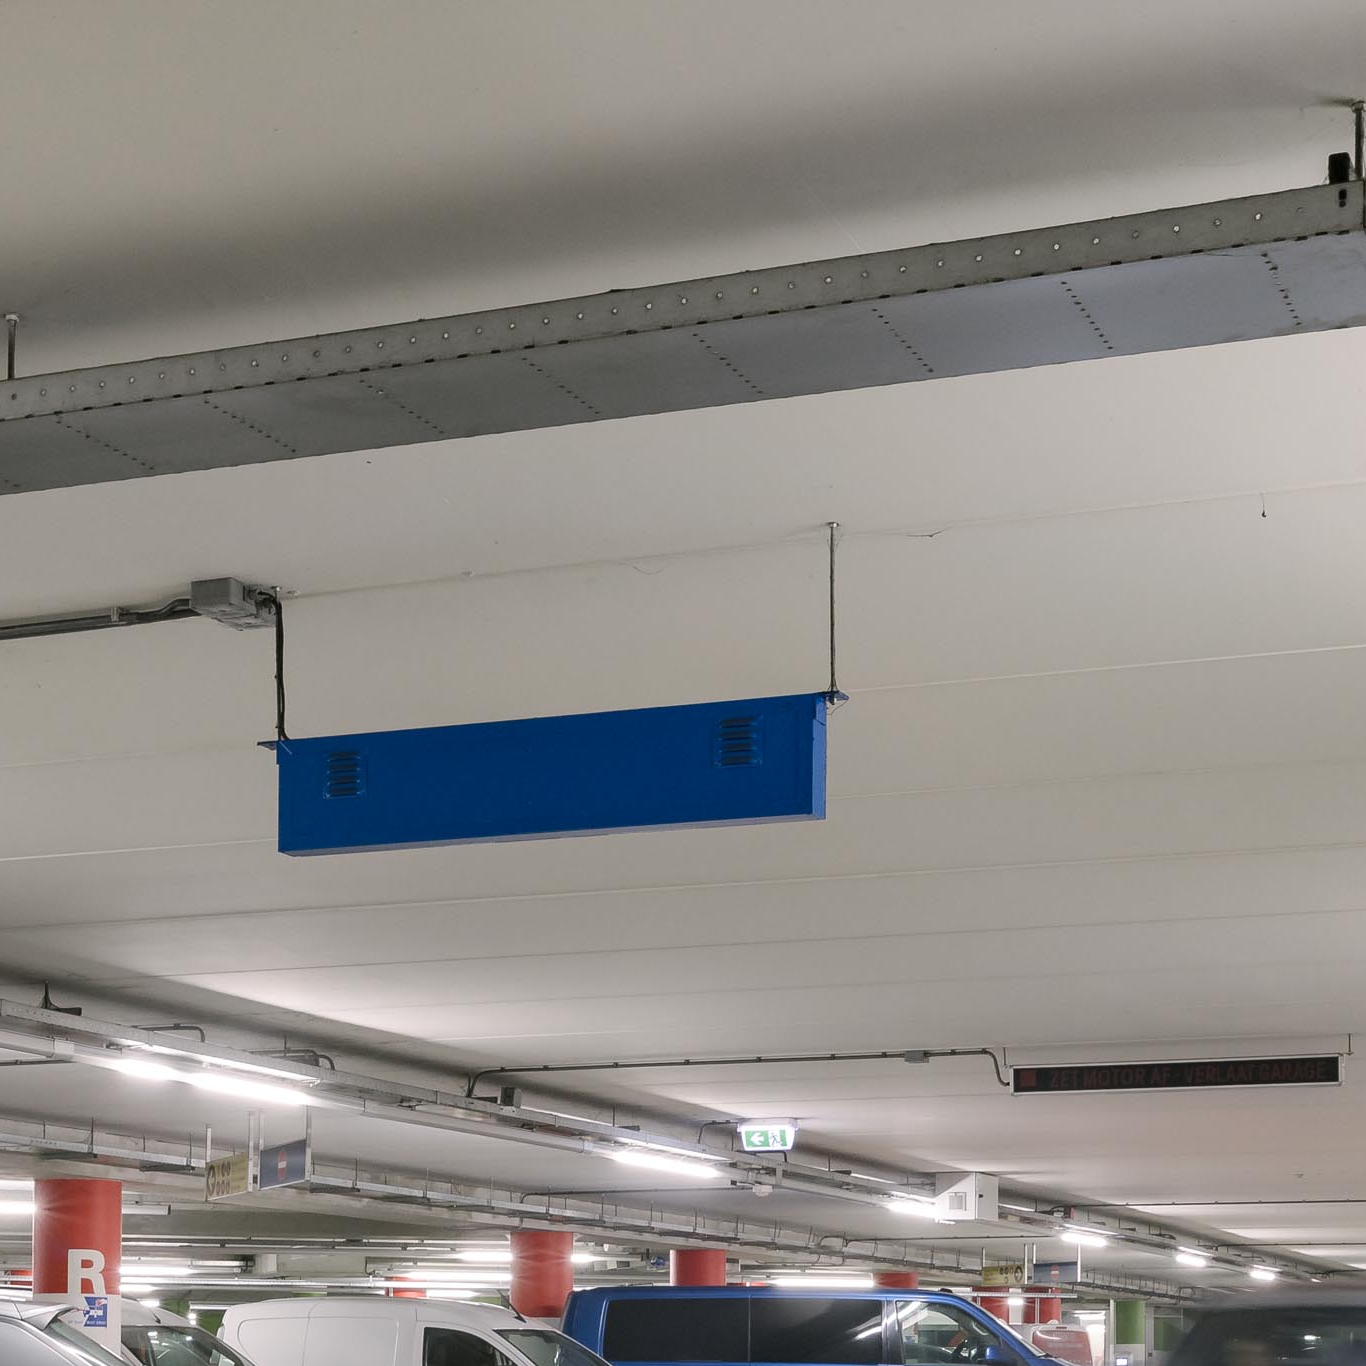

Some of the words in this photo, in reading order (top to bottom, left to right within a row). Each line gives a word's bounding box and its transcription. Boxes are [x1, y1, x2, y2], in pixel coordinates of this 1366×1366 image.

[1083, 1067, 1146, 1088] MOTOR
[1150, 1065, 1172, 1083] AF
[1185, 1063, 1253, 1082] VERLAAT
[1259, 1060, 1324, 1081] GARAGE
[67, 1249, 106, 1296] R
